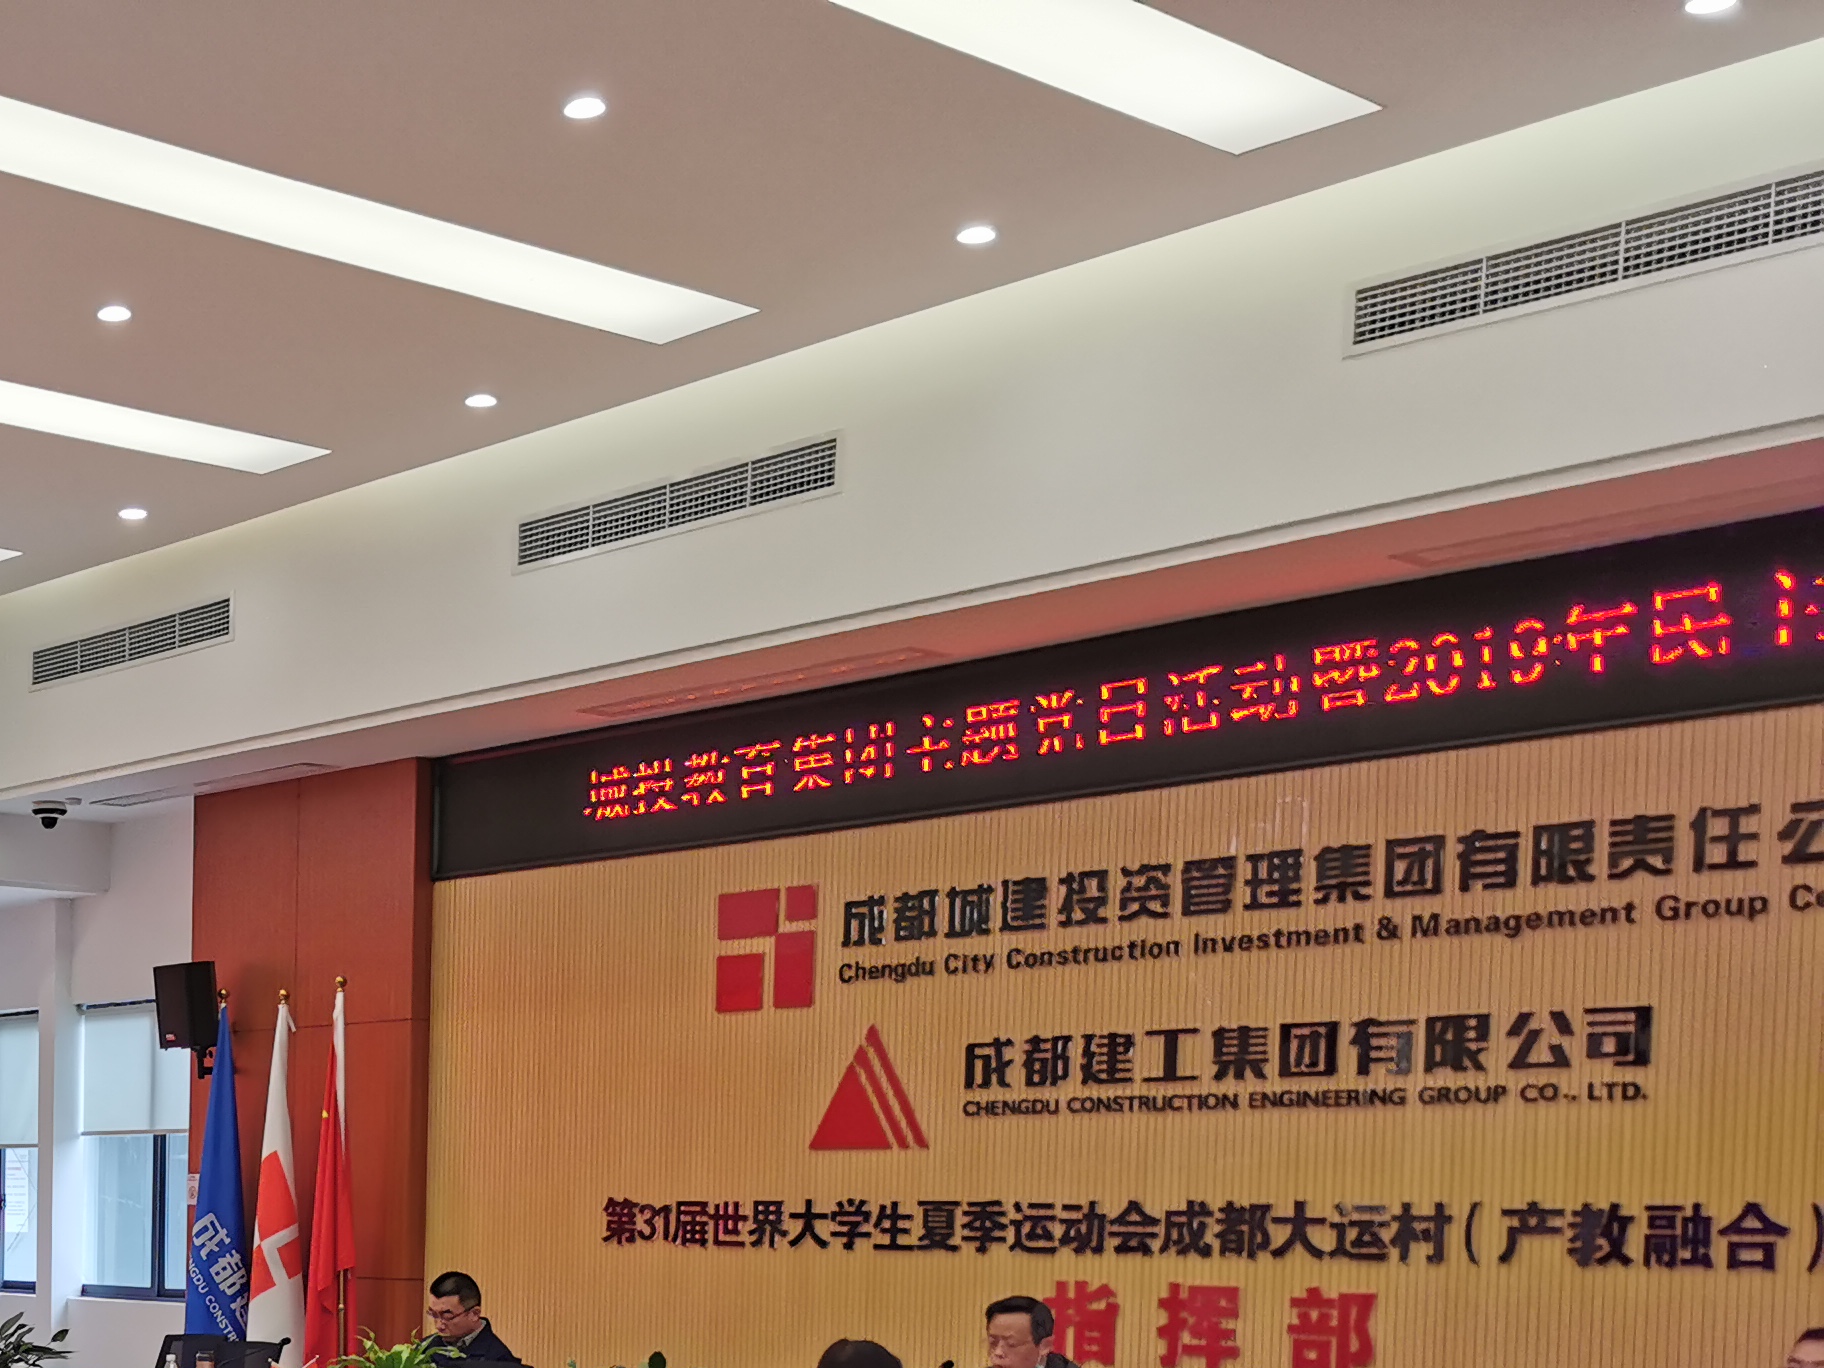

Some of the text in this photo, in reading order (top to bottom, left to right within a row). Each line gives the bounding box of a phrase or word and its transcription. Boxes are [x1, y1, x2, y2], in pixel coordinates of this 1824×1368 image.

[838, 956, 936, 984] Chengdu
[943, 952, 995, 976] City
[1006, 936, 1181, 970] Construction
[1193, 920, 1366, 957] Investment
[1376, 915, 1401, 941] &
[1411, 903, 1637, 939] Management
[1656, 893, 1769, 922] Group
[963, 1004, 1654, 1089] 成都建工集团有限公司
[963, 1097, 1060, 1117] CHENGDU
[1066, 1091, 1239, 1114] CONSTRUCTION
[1248, 1086, 1406, 1108] ENGINEERING
[1418, 1084, 1507, 1105] GROUP
[1587, 1080, 1648, 1101] LTD.
